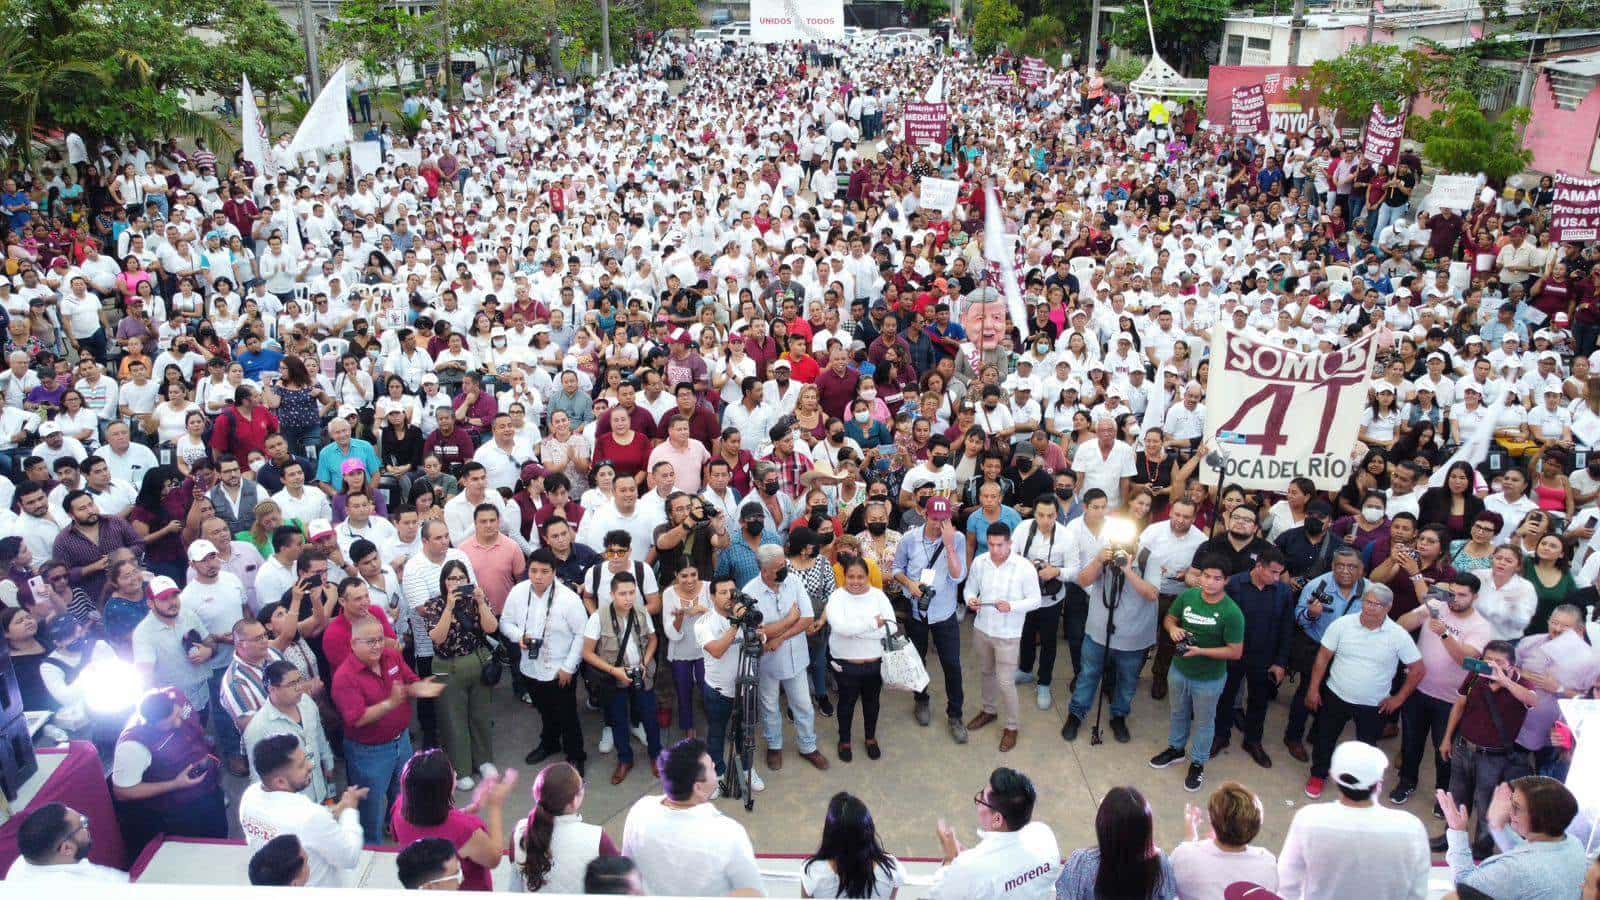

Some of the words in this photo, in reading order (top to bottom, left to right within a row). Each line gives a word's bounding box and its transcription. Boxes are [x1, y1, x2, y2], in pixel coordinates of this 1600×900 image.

[759, 17, 792, 25] UNIDOS
[806, 17, 835, 25] TODOS
[905, 112, 946, 121] MEDELLÍN
[1268, 107, 1315, 133] POYO!
[1553, 217, 1588, 228] #USA
[1222, 458, 1264, 479] OCA
[1268, 458, 1304, 479] DEL
[1308, 452, 1346, 479] RÍO
[934, 501, 946, 512] m
[1004, 862, 1051, 893] morena
